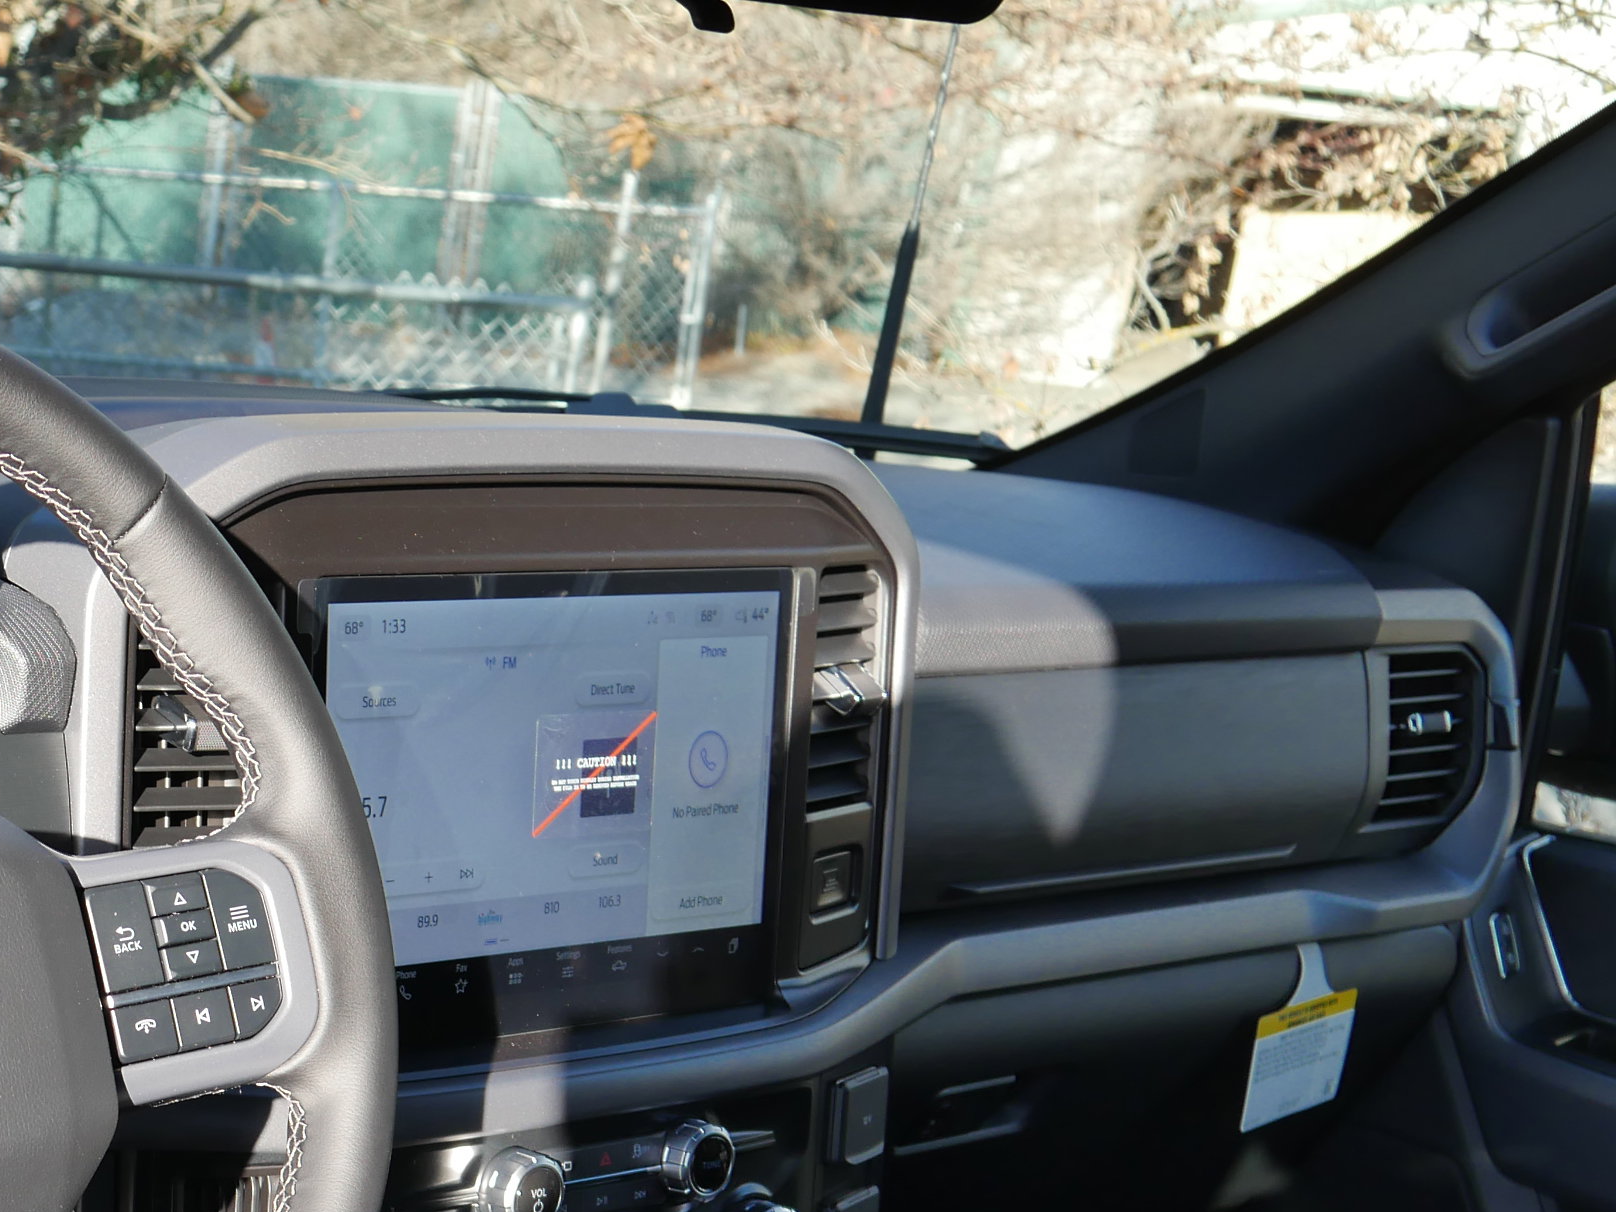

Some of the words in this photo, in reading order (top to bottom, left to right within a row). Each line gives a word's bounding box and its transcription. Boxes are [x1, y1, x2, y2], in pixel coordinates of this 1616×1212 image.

[382, 618, 407, 634] 1:33
[700, 645, 727, 658] Phone
[502, 656, 517, 669] FM
[590, 683, 614, 696] Direct
[615, 682, 636, 695] Tune
[576, 755, 617, 769] CAUTION
[672, 807, 685, 818] No
[685, 804, 712, 817] Paired
[713, 802, 739, 815] Phone
[592, 854, 618, 867] Sound
[679, 898, 696, 909] Add
[697, 894, 723, 907] Phone
[181, 920, 197, 932] OK
[227, 918, 258, 933] MENU
[417, 913, 439, 928] 89.9
[113, 940, 143, 955] BACK
[456, 963, 468, 973] Fav
[530, 1188, 547, 1199] VOL
